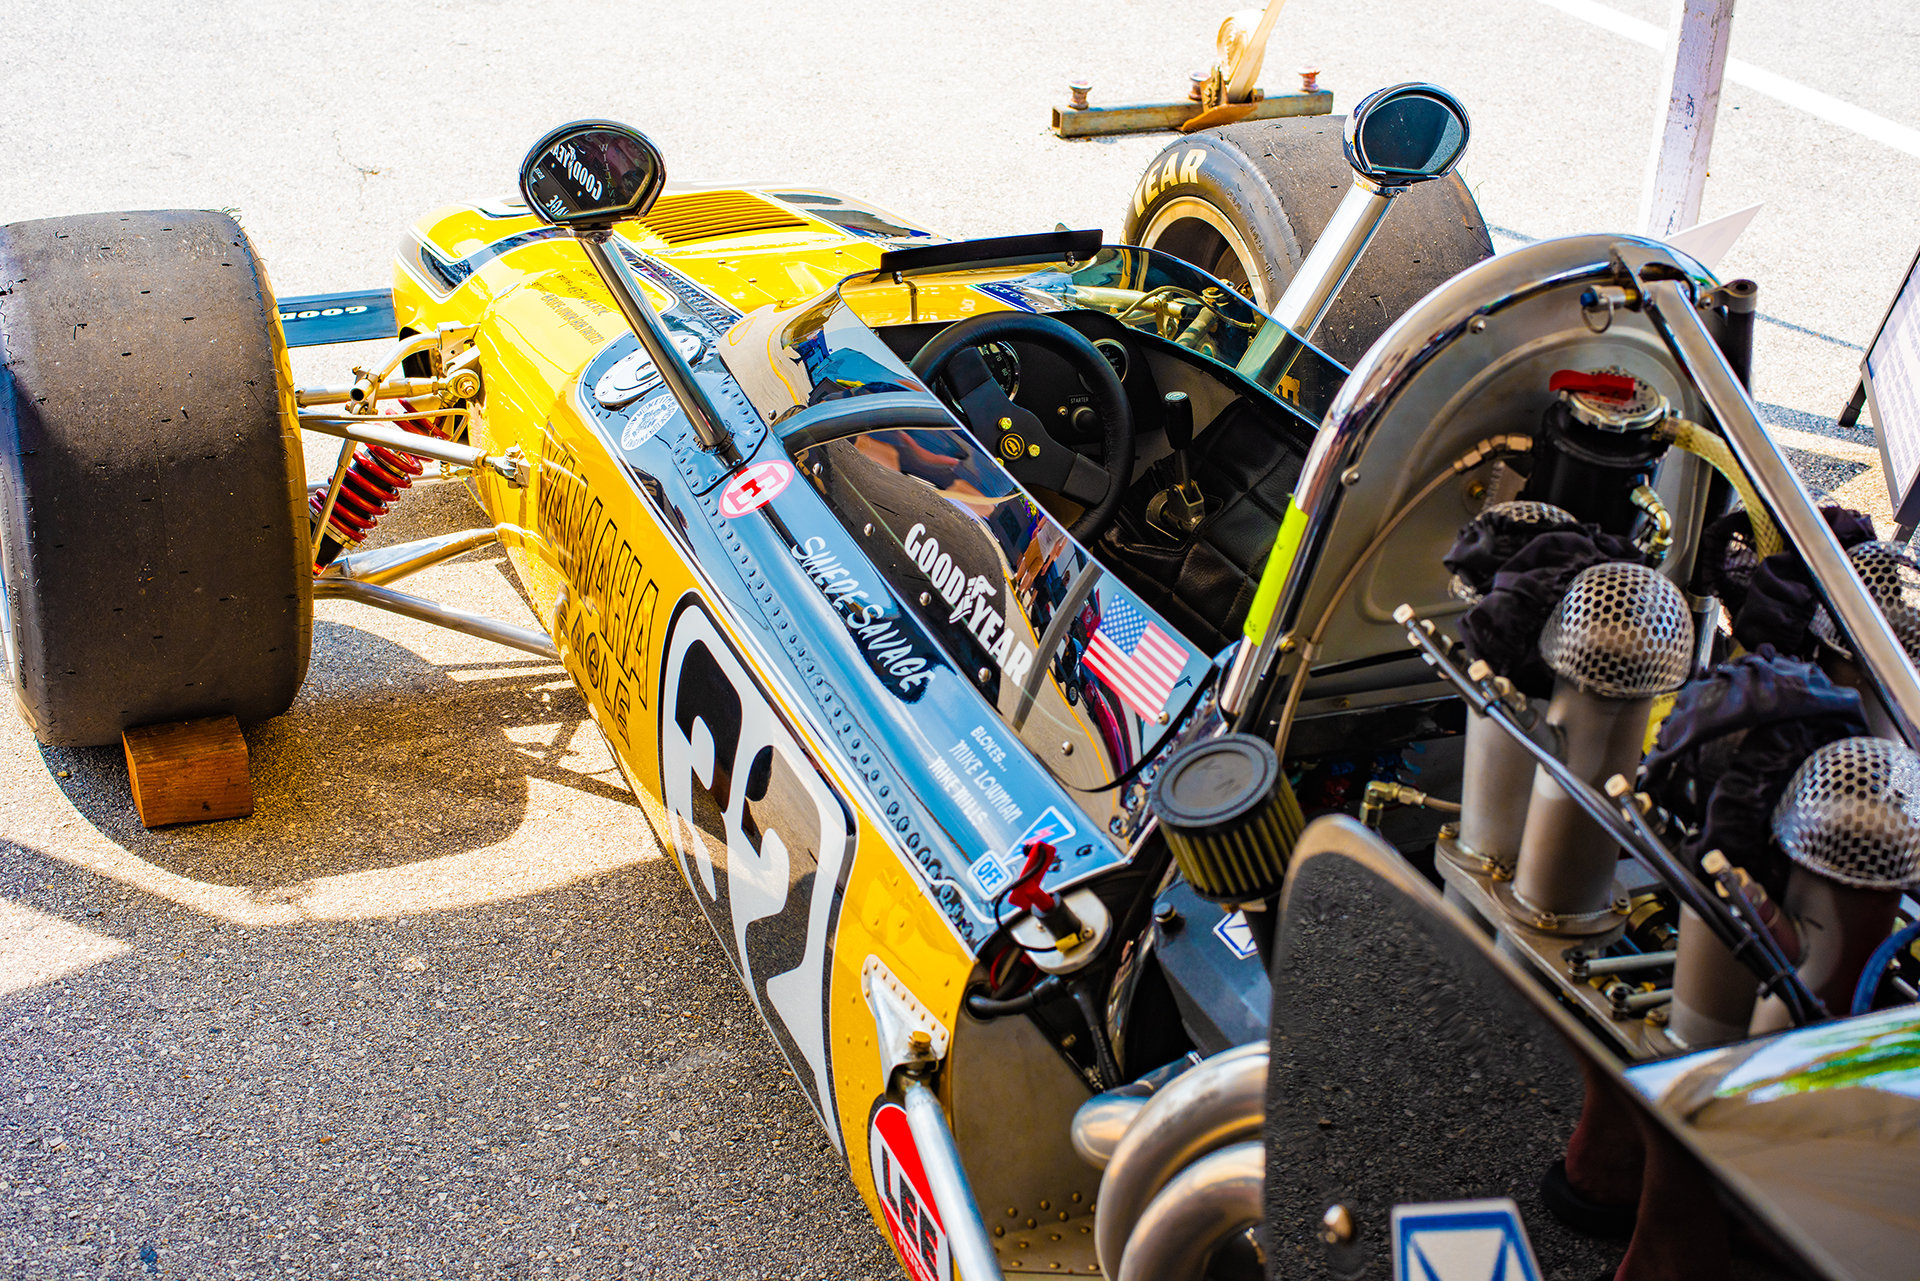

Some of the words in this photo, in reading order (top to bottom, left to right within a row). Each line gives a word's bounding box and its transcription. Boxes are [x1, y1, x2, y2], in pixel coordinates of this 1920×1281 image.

[279, 305, 368, 321] GOOD
[1070, 396, 1089, 404] STARTER
[538, 420, 659, 711] YAMAHA
[904, 522, 1034, 688] GOODYEAR
[791, 536, 870, 610] SWEDE
[846, 604, 936, 693] SAVAGE
[928, 756, 962, 794] MIKE
[951, 784, 988, 827] MILLS
[948, 739, 984, 776] MIKE
[973, 769, 1024, 825] LOWMAN
[977, 860, 1004, 888] OFF
[881, 1143, 940, 1281] LEE
